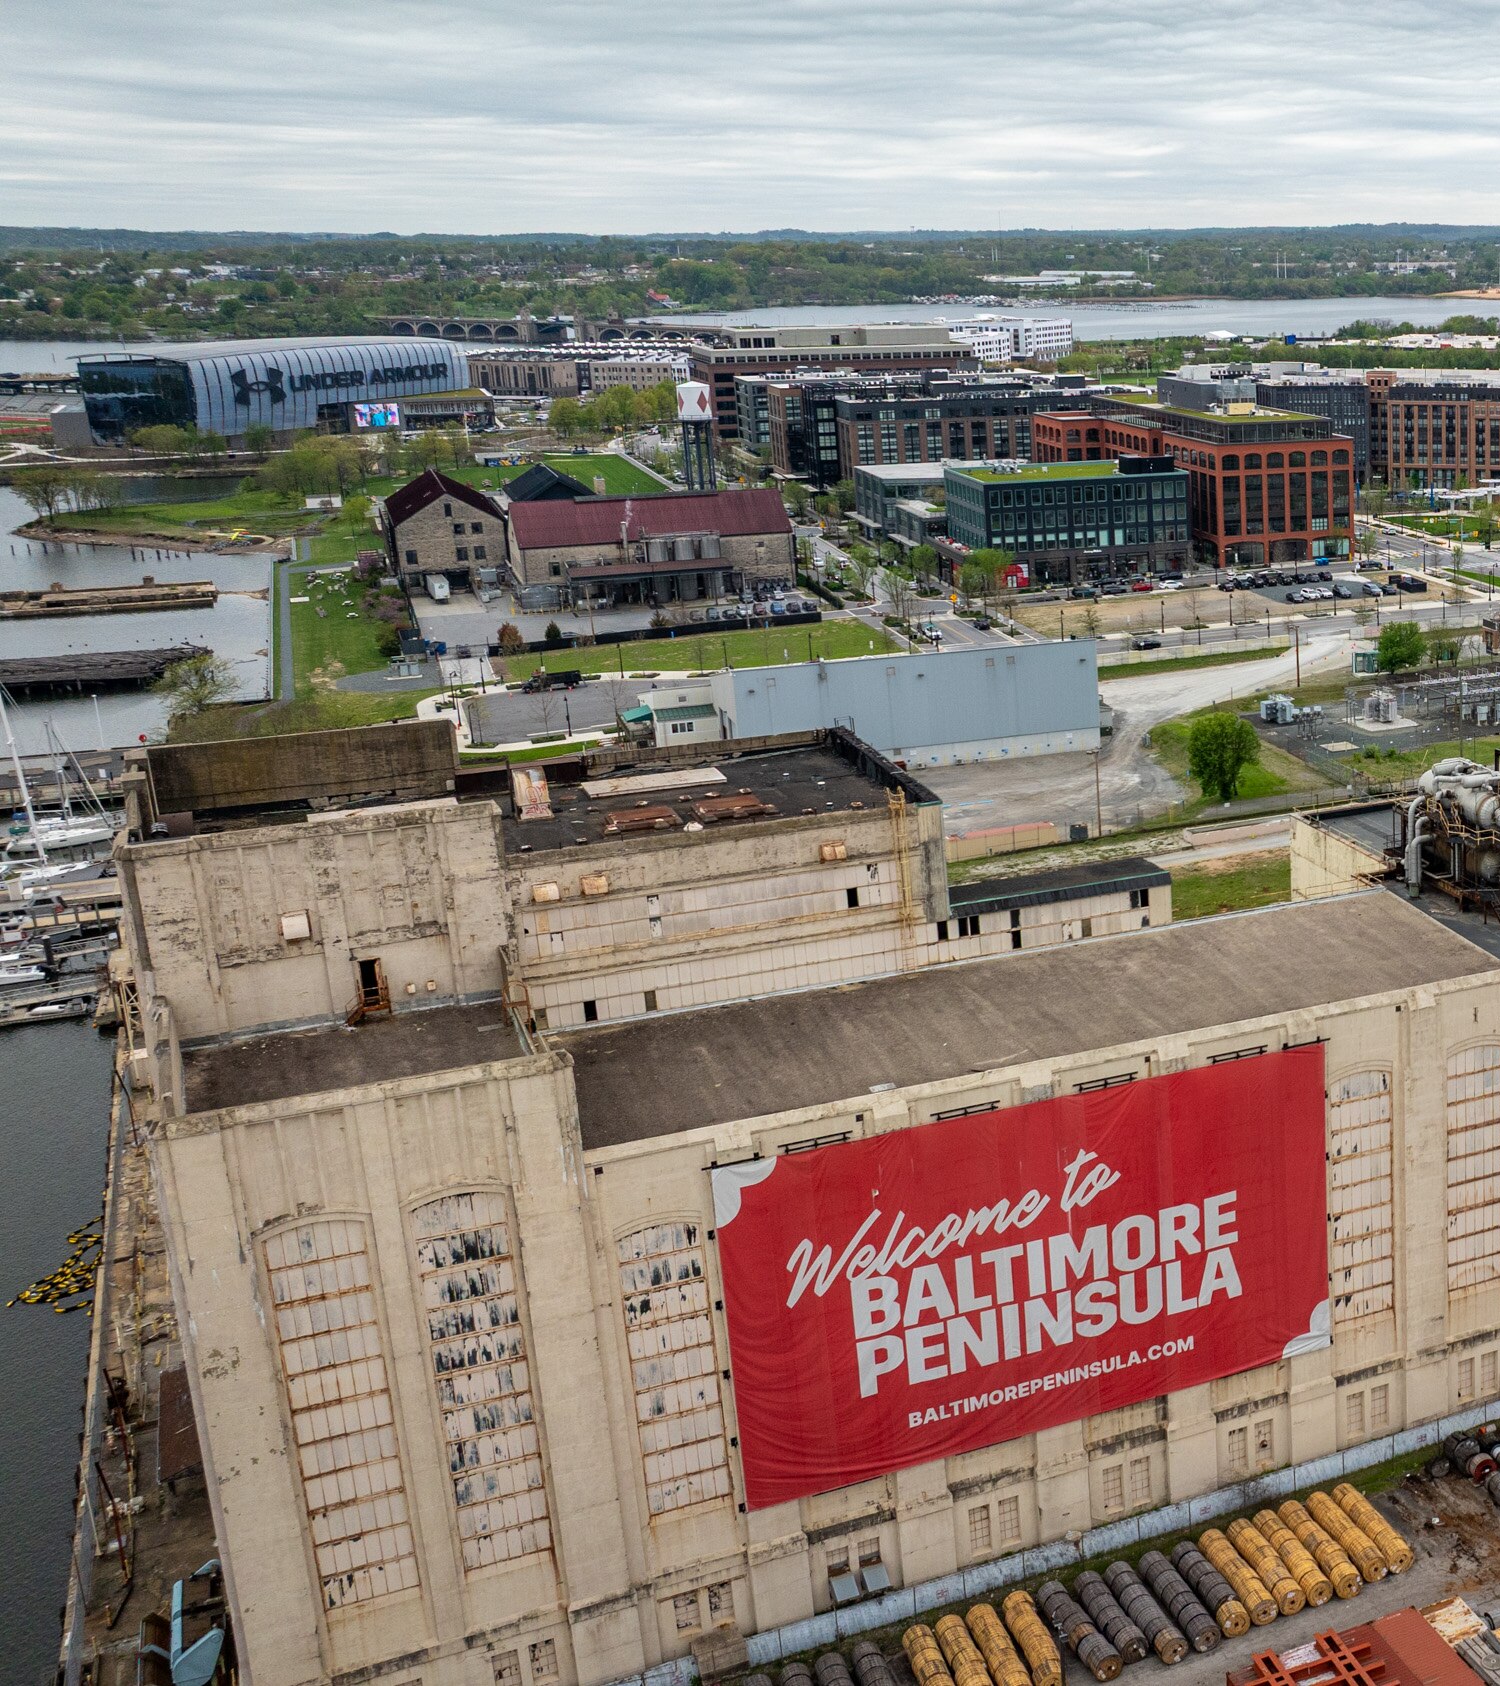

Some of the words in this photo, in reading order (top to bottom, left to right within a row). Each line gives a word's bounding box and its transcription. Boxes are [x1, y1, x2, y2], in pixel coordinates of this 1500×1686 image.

[289, 370, 366, 392] UNDER
[370, 362, 449, 385] ARMOUR
[410, 403, 439, 414] PROTECT
[439, 402, 455, 412] THIS
[785, 1188, 1050, 1309] Welcome
[1060, 1148, 1122, 1212] to
[850, 1190, 1239, 1340] BALTIMORE
[856, 1246, 1243, 1399] PENINSULA
[908, 1336, 1195, 1429] BALTIMOREPENINSULA.COM
